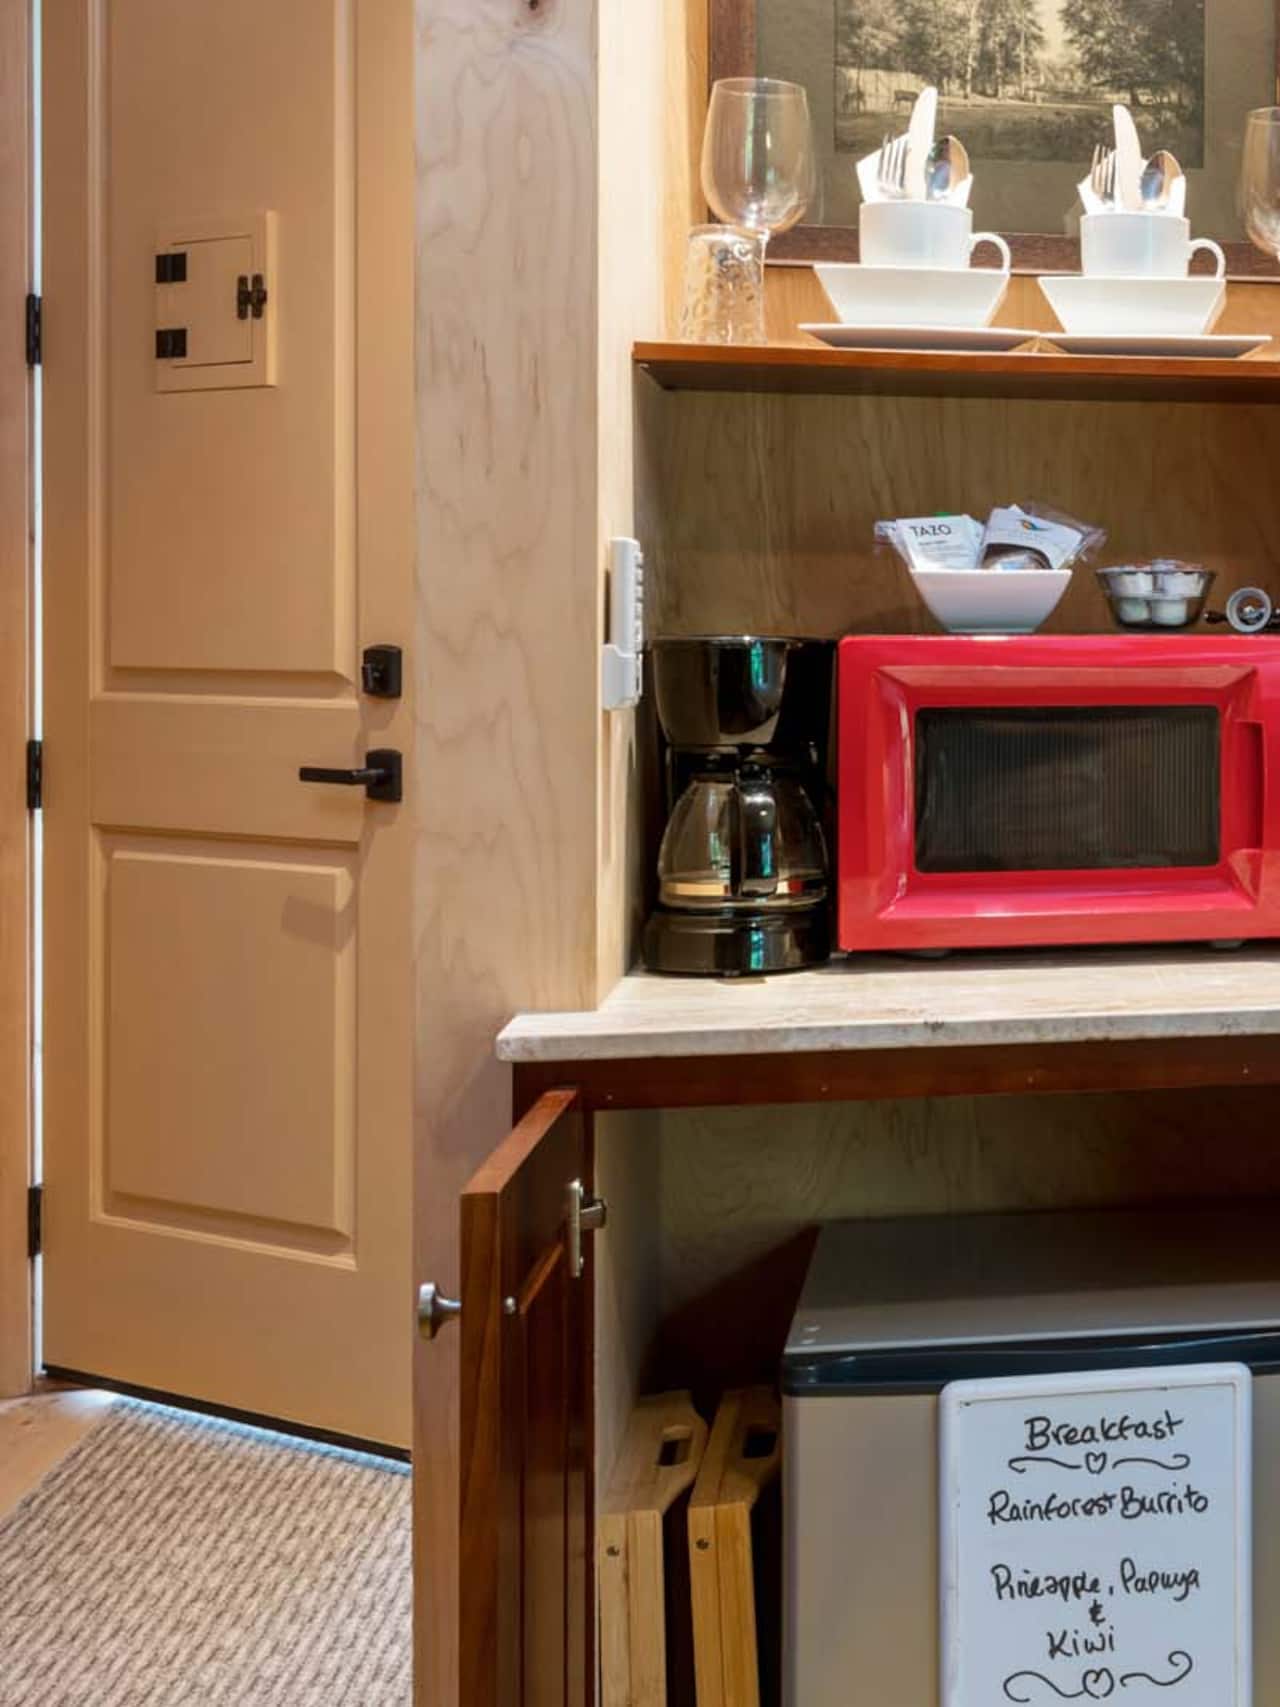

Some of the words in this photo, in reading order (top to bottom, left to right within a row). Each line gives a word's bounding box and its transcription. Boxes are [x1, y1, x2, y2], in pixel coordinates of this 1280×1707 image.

[909, 524, 952, 537] TAZO
[1024, 1410, 1183, 1450] Breakfast
[987, 1490, 1116, 1525] Rainforest
[1120, 1482, 1208, 1519] Burrito
[1047, 1625, 1115, 1659] Kiwi
